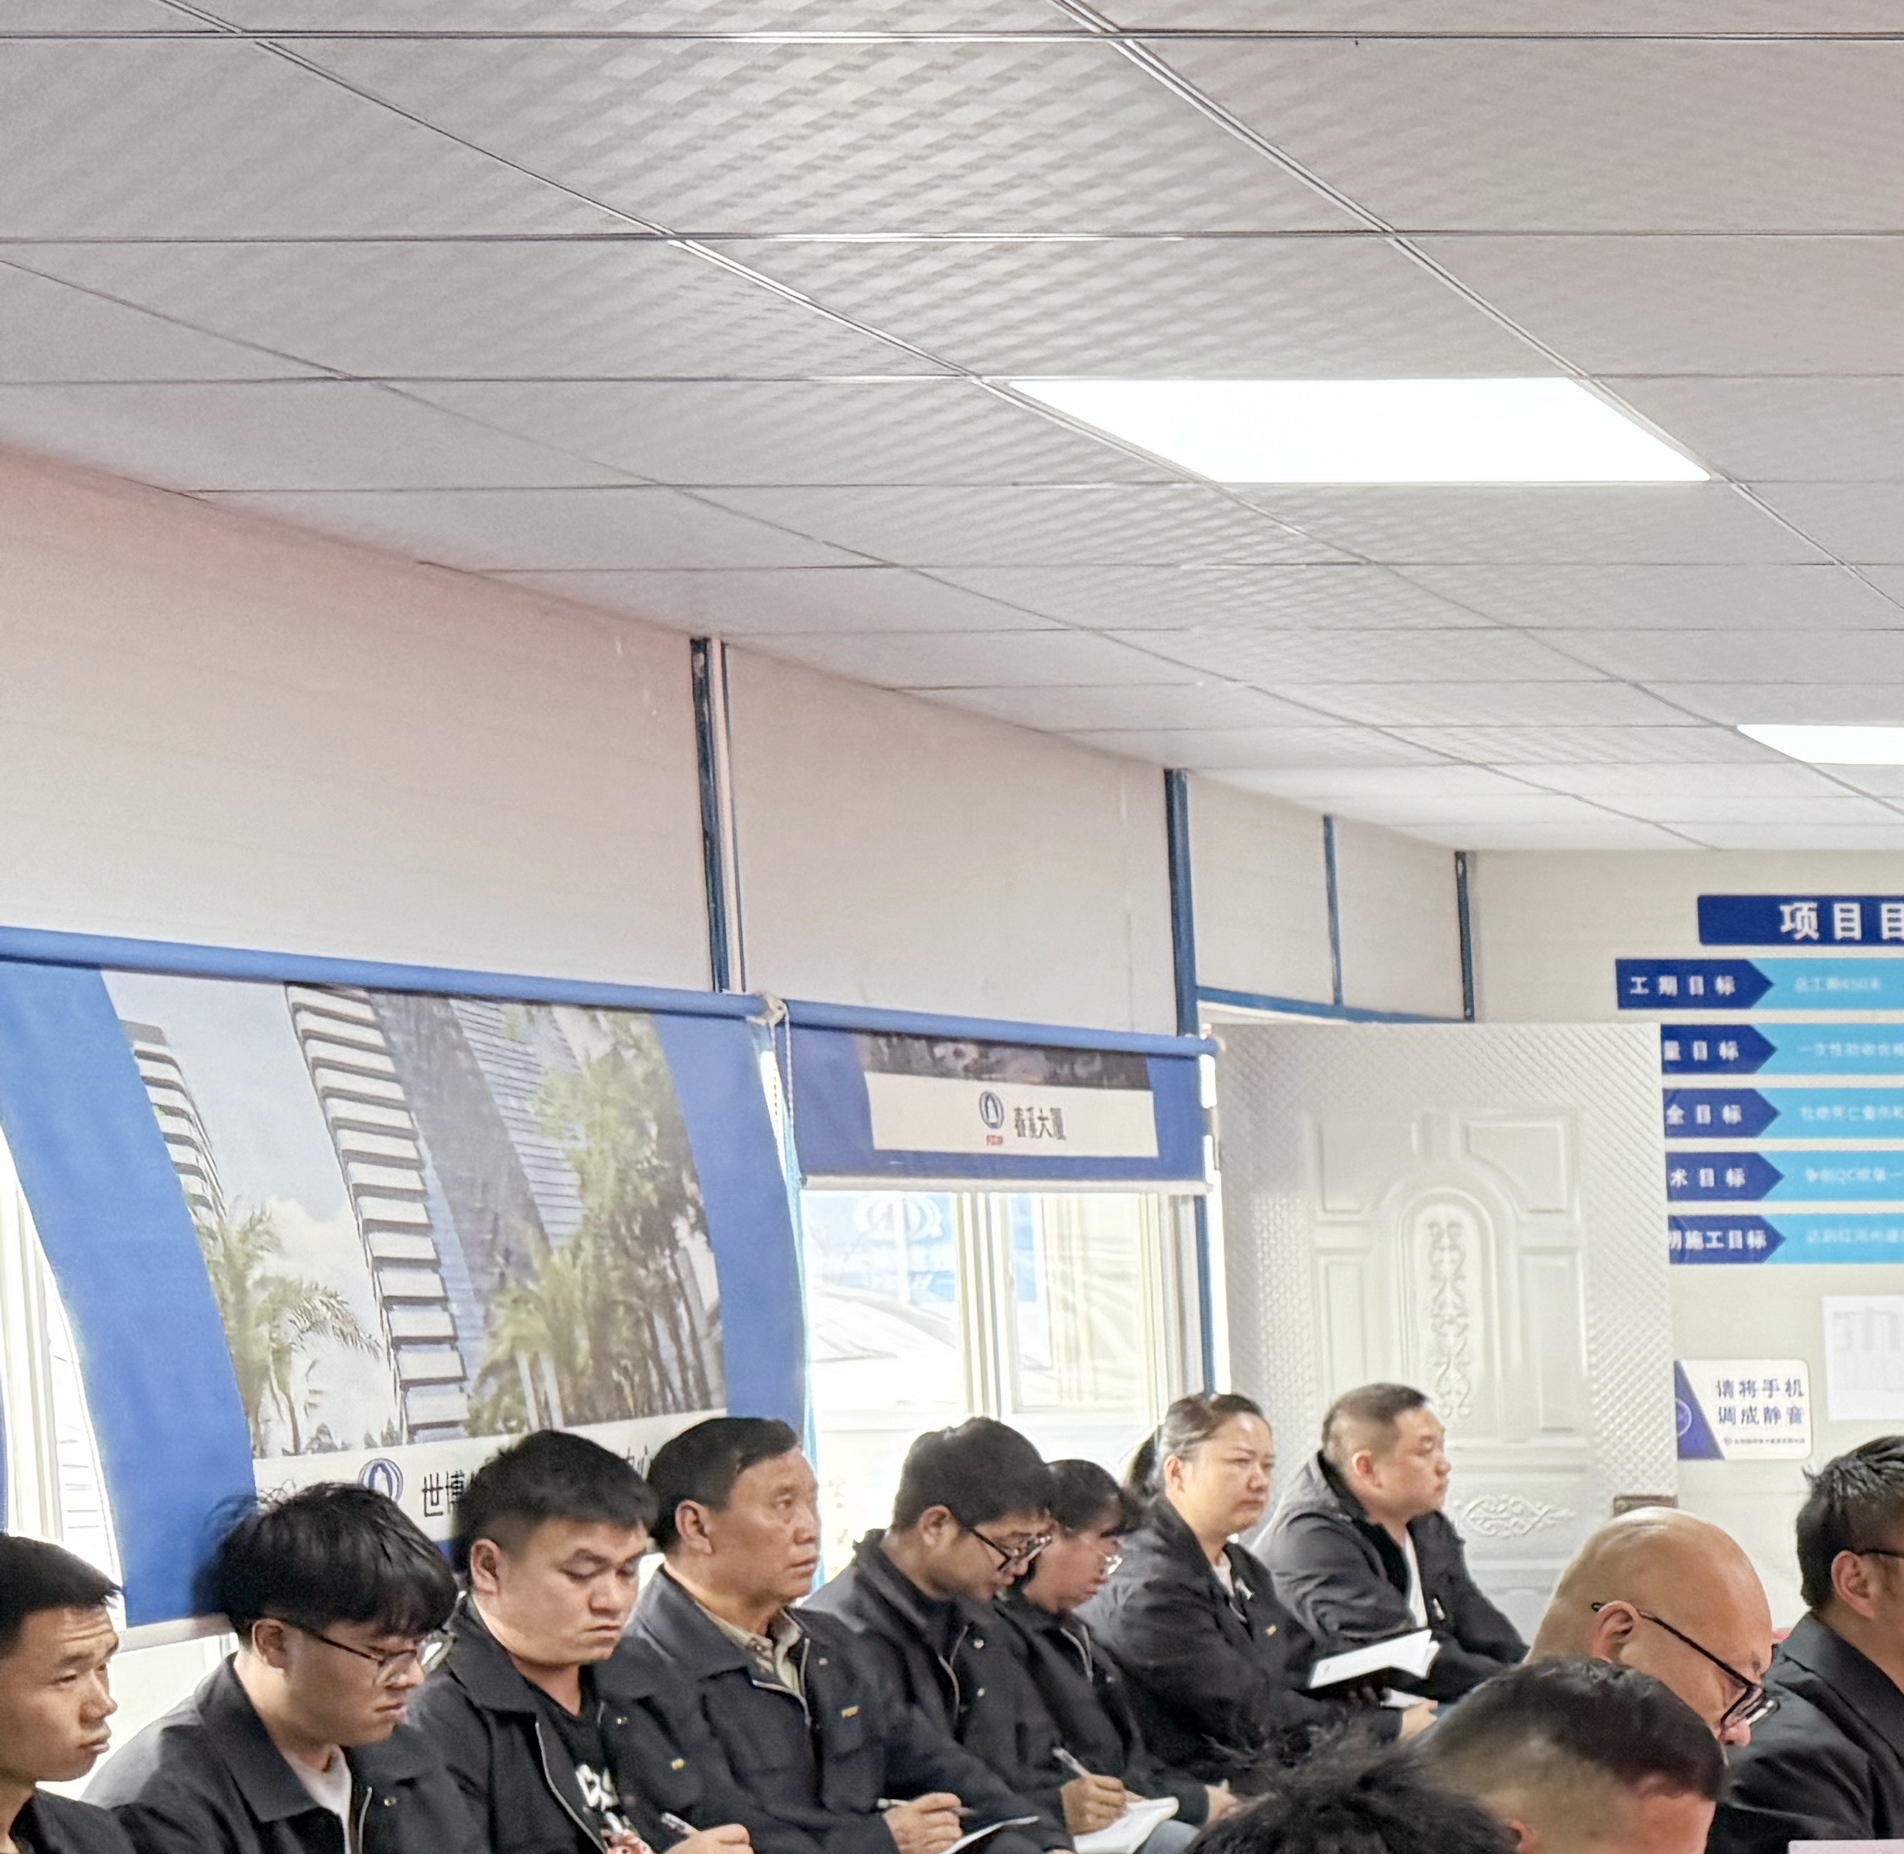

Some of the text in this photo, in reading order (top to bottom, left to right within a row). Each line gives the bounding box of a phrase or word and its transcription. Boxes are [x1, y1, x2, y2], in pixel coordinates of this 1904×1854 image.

[1630, 975, 1736, 997] 工期目标
[1716, 1378, 1804, 1399] 请将手机
[1718, 1406, 1804, 1426] 调成静音
